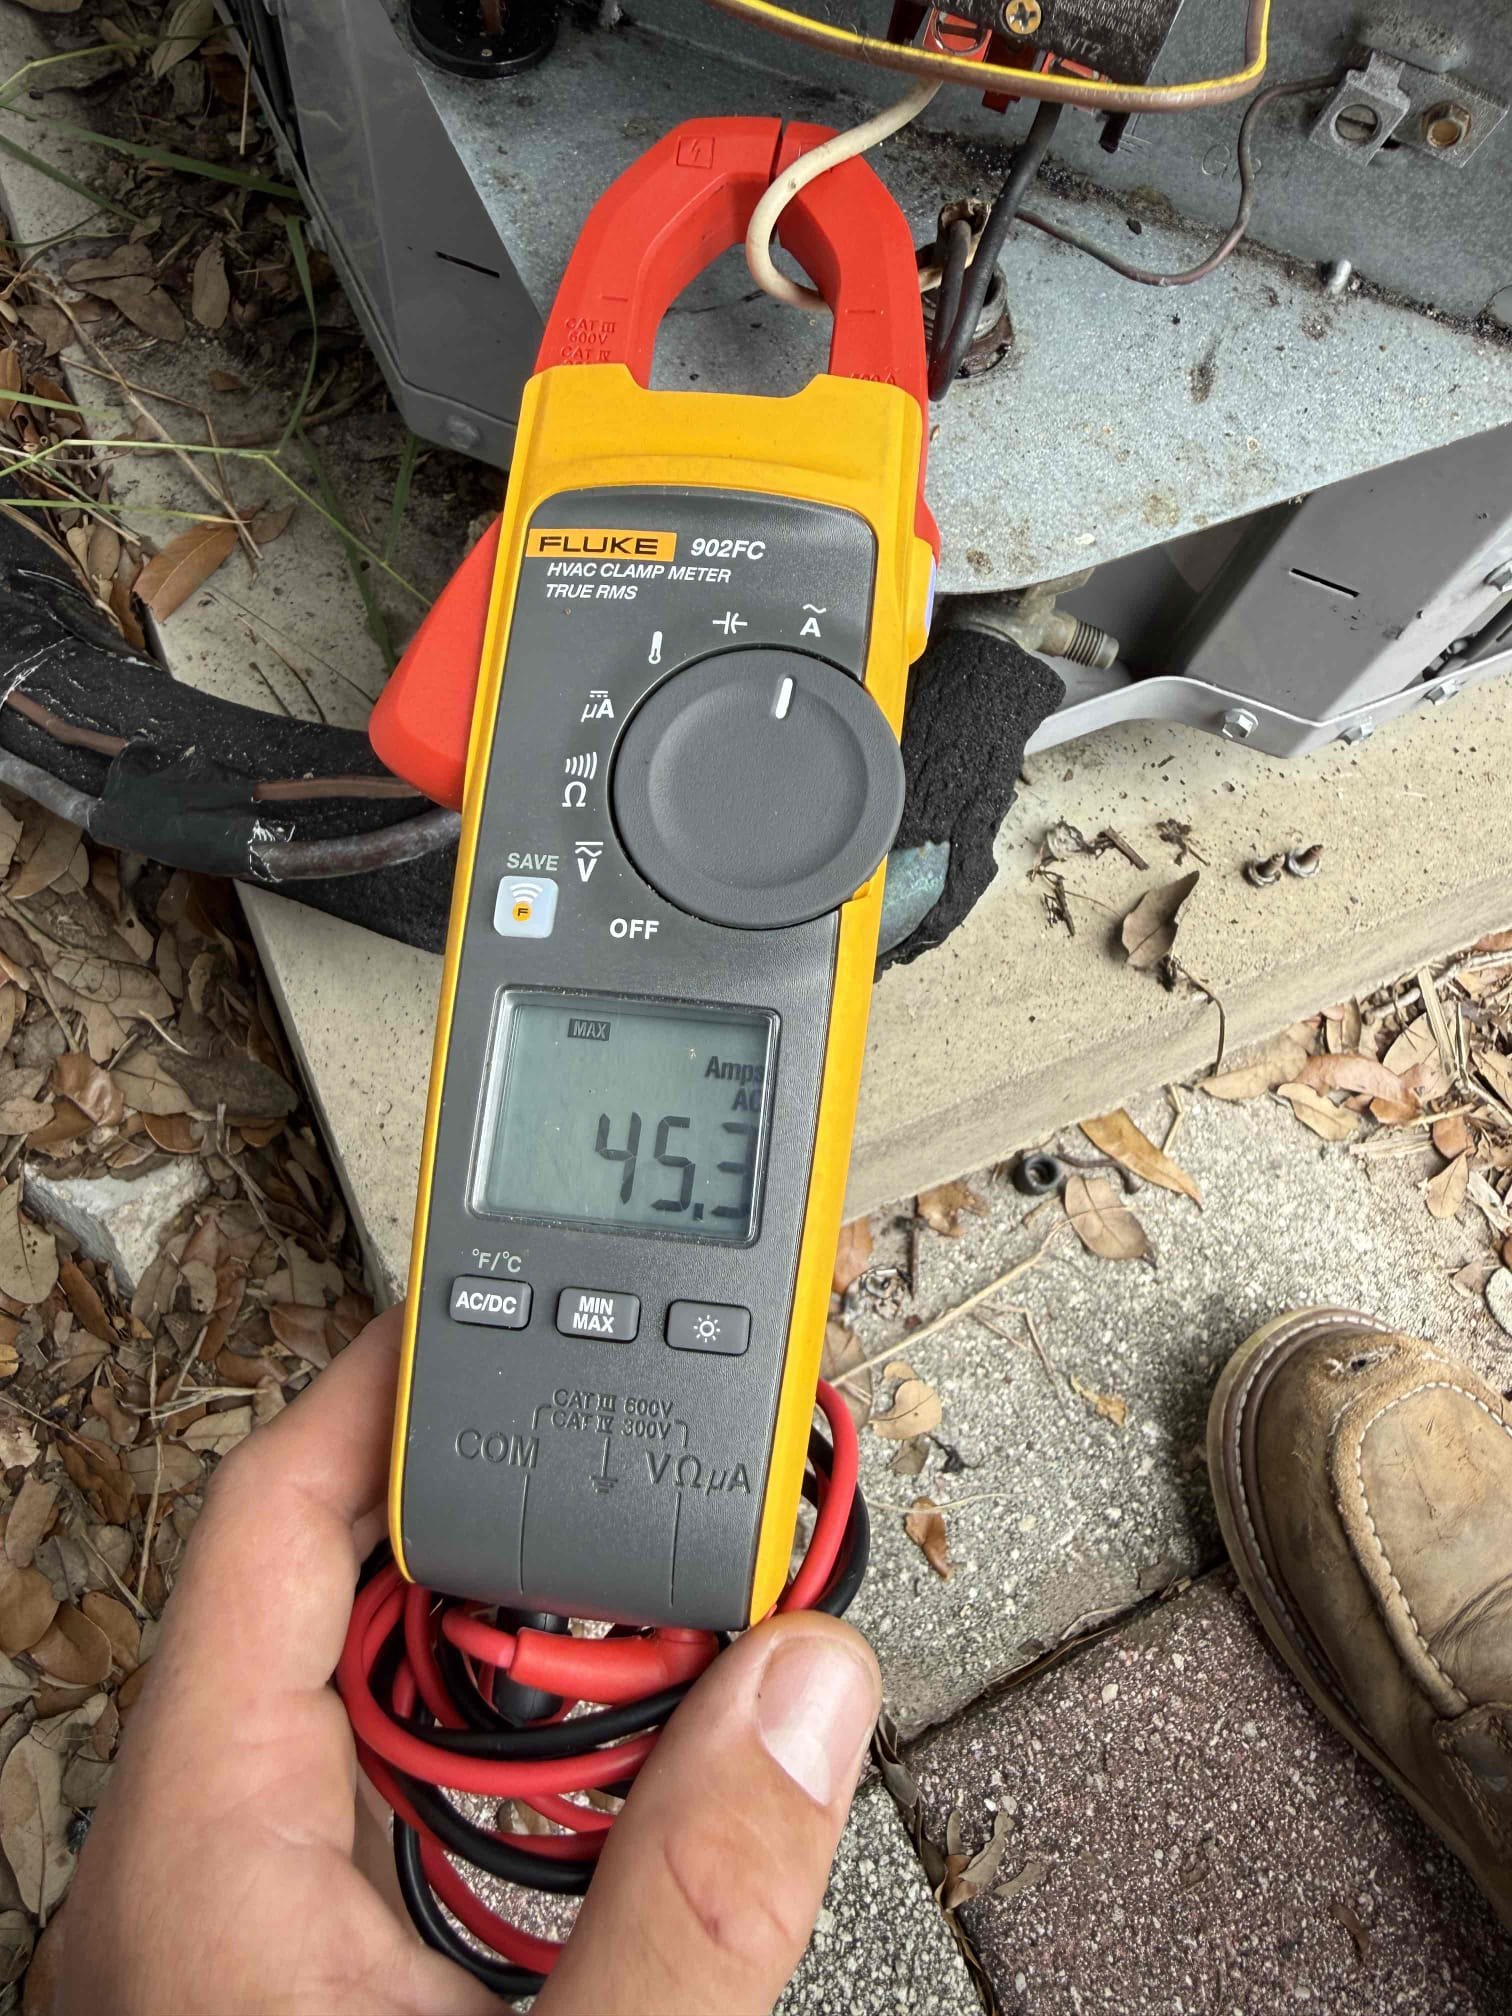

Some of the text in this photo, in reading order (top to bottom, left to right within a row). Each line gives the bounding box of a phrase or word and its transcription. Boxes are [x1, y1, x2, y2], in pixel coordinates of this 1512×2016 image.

[564, 317, 617, 333] CAT III
[567, 329, 608, 345] 600V
[560, 345, 593, 361] CAT
[538, 535, 766, 561] FLUKE 902FC
[546, 562, 732, 583] HVAC CLAMP METER
[545, 583, 638, 601] TRUE RMS
[506, 852, 560, 872] SAVE
[608, 918, 660, 940] OFF
[572, 1022, 608, 1040] MAX
[472, 1248, 522, 1273] °F/°C
[455, 1291, 517, 1315] AC/DC
[579, 1295, 614, 1316] MIN
[572, 1314, 615, 1333] MAX
[551, 1388, 674, 1419] CAT III 600V
[550, 1410, 672, 1440] CAT IV 300V
[454, 1428, 540, 1469] COM
